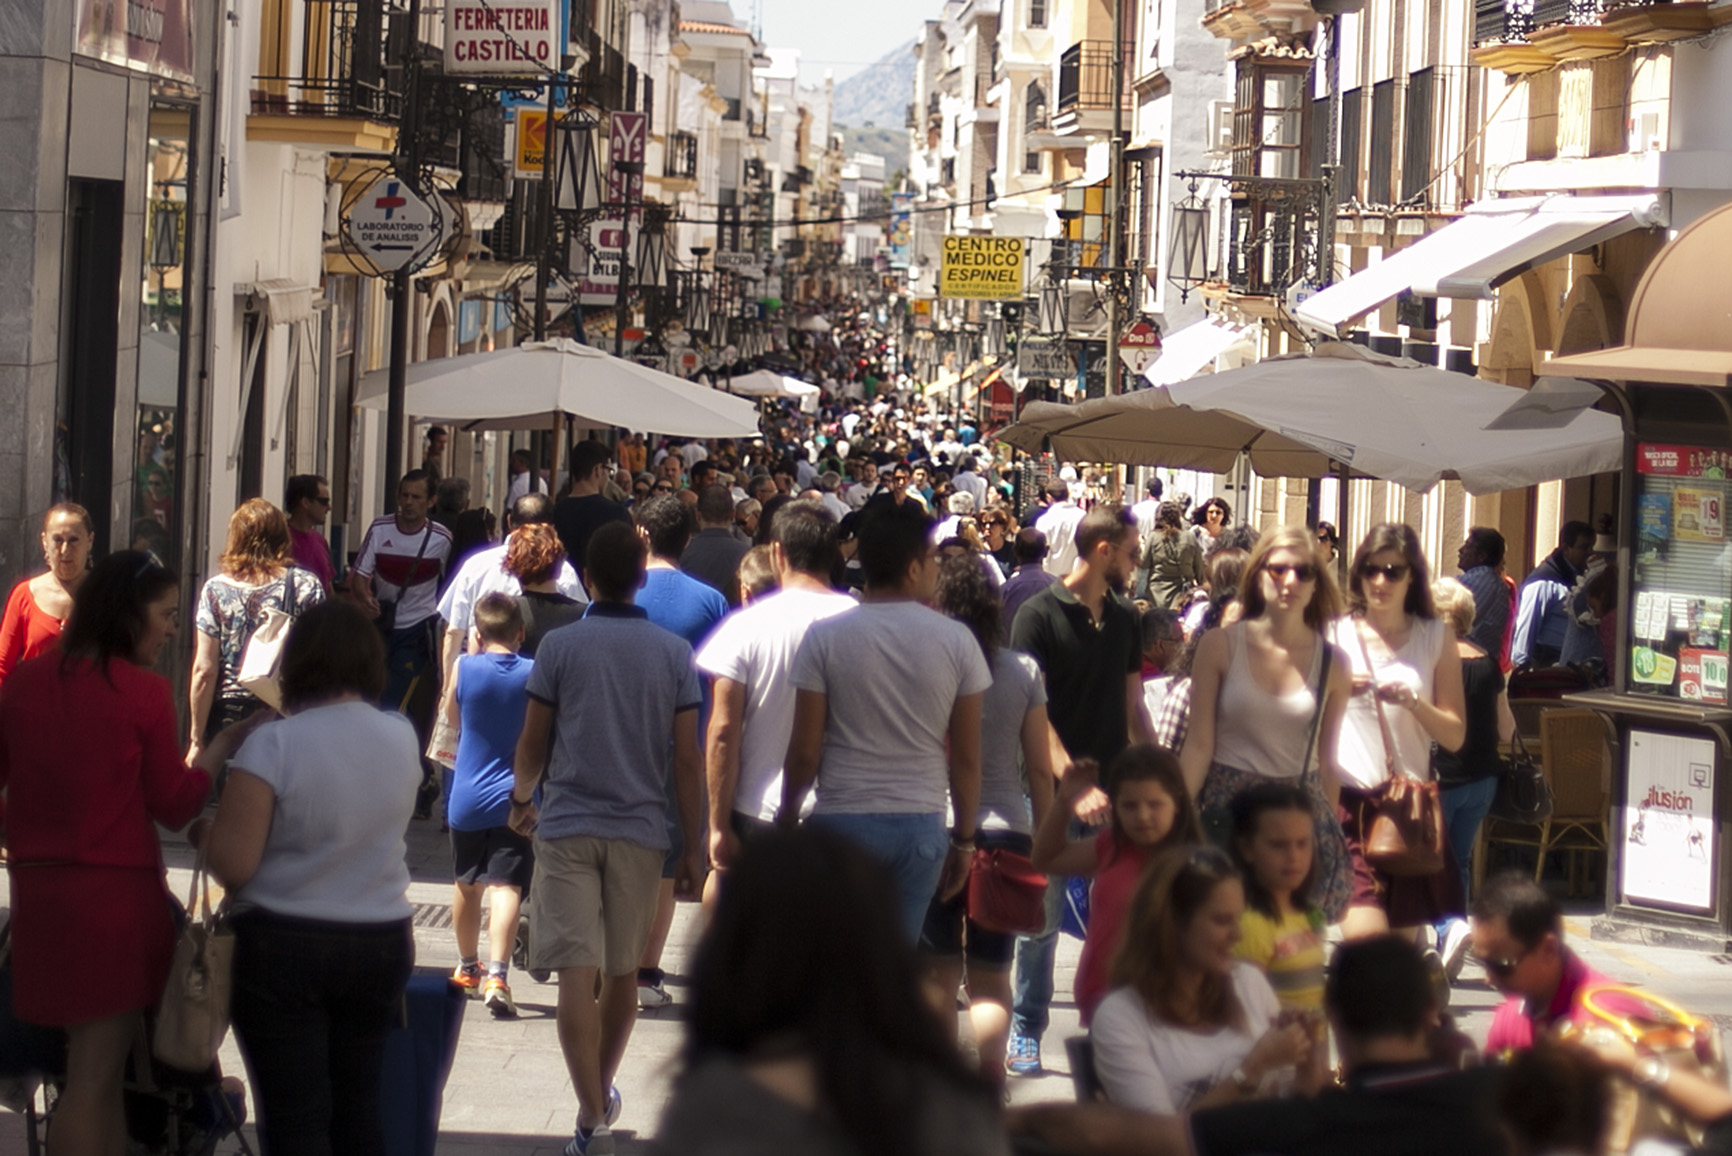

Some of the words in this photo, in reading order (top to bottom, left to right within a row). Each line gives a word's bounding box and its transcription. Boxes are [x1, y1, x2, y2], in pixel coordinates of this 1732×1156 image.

[454, 8, 549, 31] FERRETERIA
[454, 39, 550, 61] CASTILLO
[357, 222, 424, 232] LABORATORIO
[362, 232, 375, 241] DE
[377, 233, 419, 242] ANALISIS
[944, 237, 1022, 252] CENTRO
[946, 252, 1019, 267] MEDICO
[947, 268, 1018, 282] ESPINEL
[1648, 785, 1693, 811] ilusión
